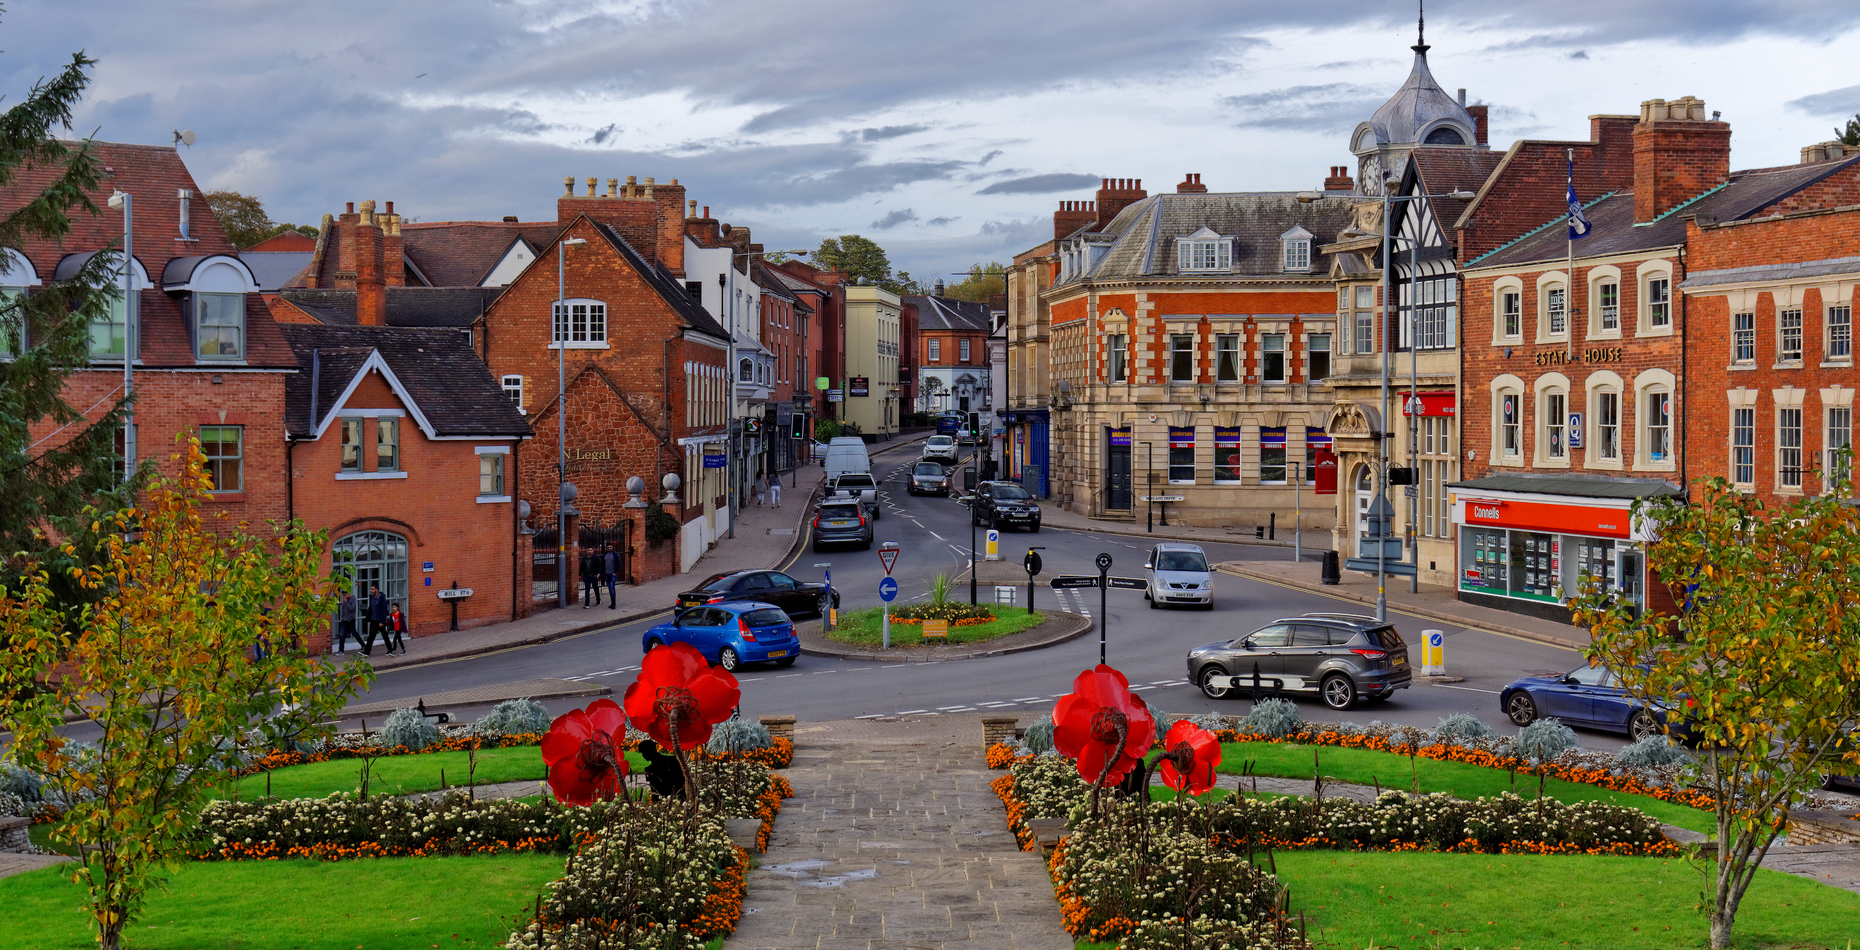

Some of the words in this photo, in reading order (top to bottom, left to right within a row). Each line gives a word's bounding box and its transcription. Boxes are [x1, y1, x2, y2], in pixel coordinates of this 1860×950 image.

[1585, 347, 1622, 362] HOUSE
[576, 448, 611, 462] Legal
[1474, 505, 1500, 520] Connells
